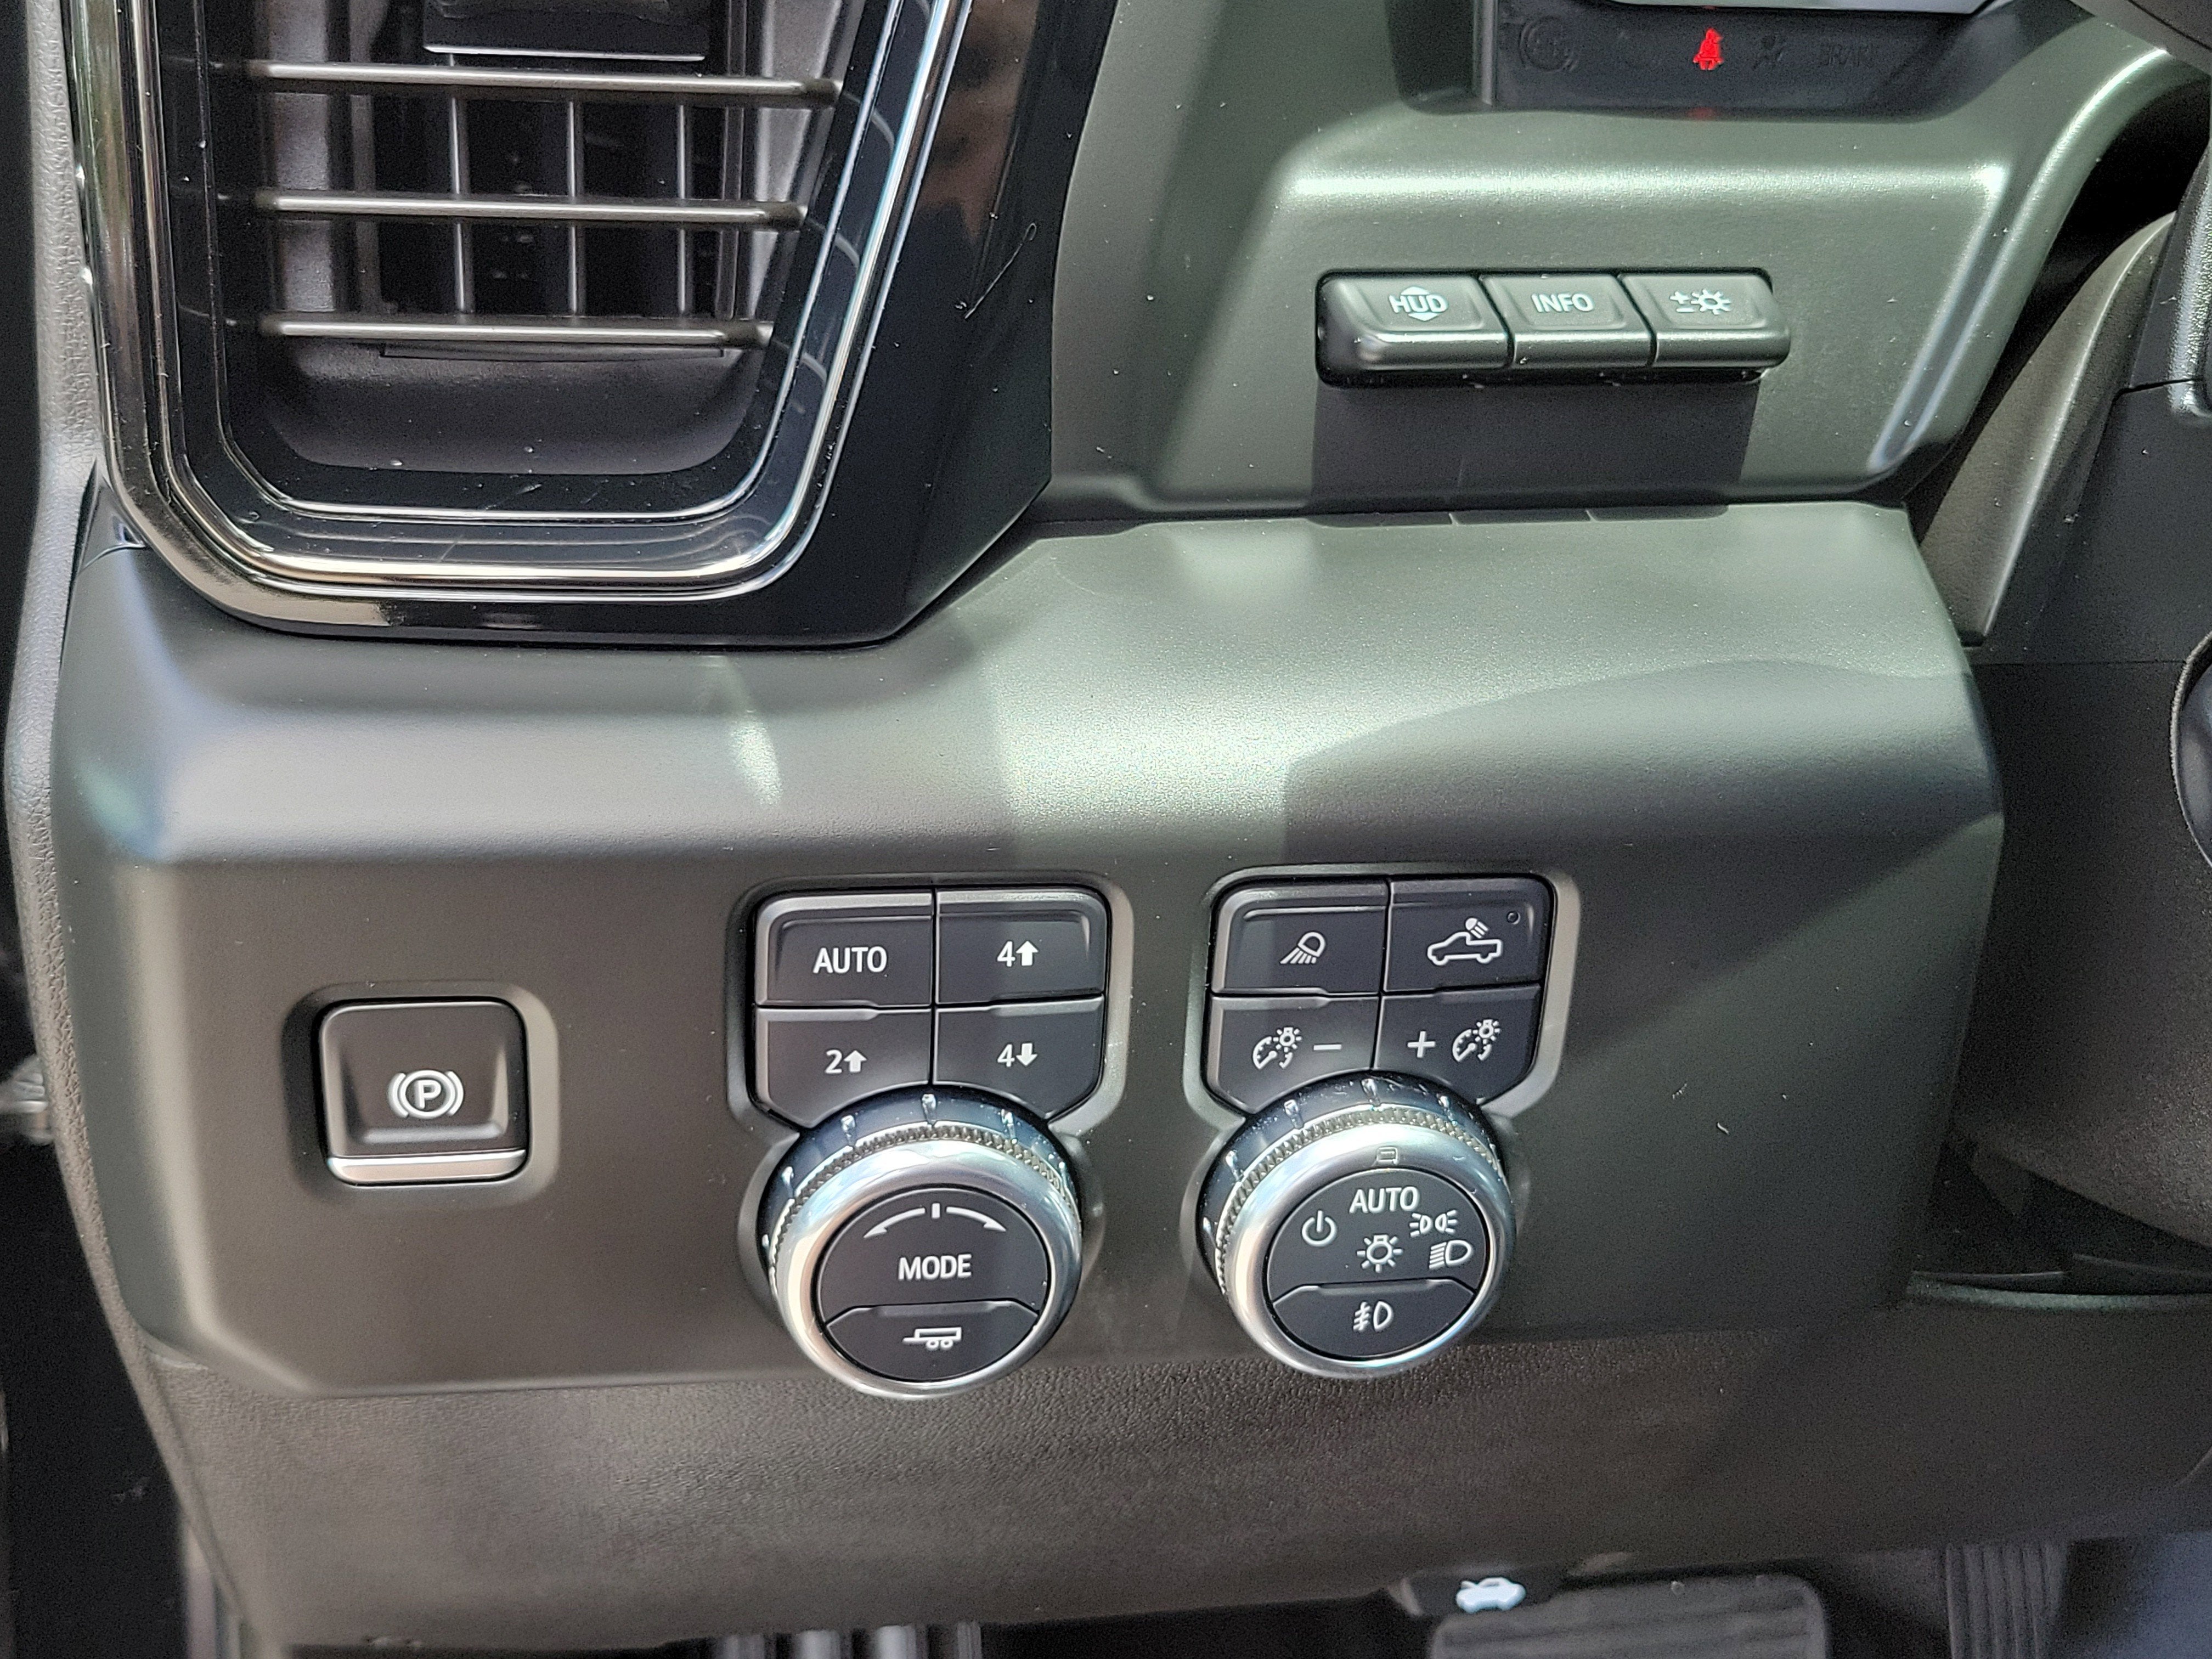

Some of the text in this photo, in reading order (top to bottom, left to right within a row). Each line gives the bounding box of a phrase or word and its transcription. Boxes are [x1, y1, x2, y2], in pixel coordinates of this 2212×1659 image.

[1388, 294, 1448, 313] HUD
[1531, 293, 1594, 313] INFO
[813, 946, 887, 974] AUTO
[996, 941, 1015, 968] 4
[825, 1049, 843, 1074] 2
[997, 1043, 1015, 1068] 4
[414, 1079, 442, 1109] P
[1349, 1186, 1419, 1214] AUTO
[898, 1254, 972, 1280] MODE
